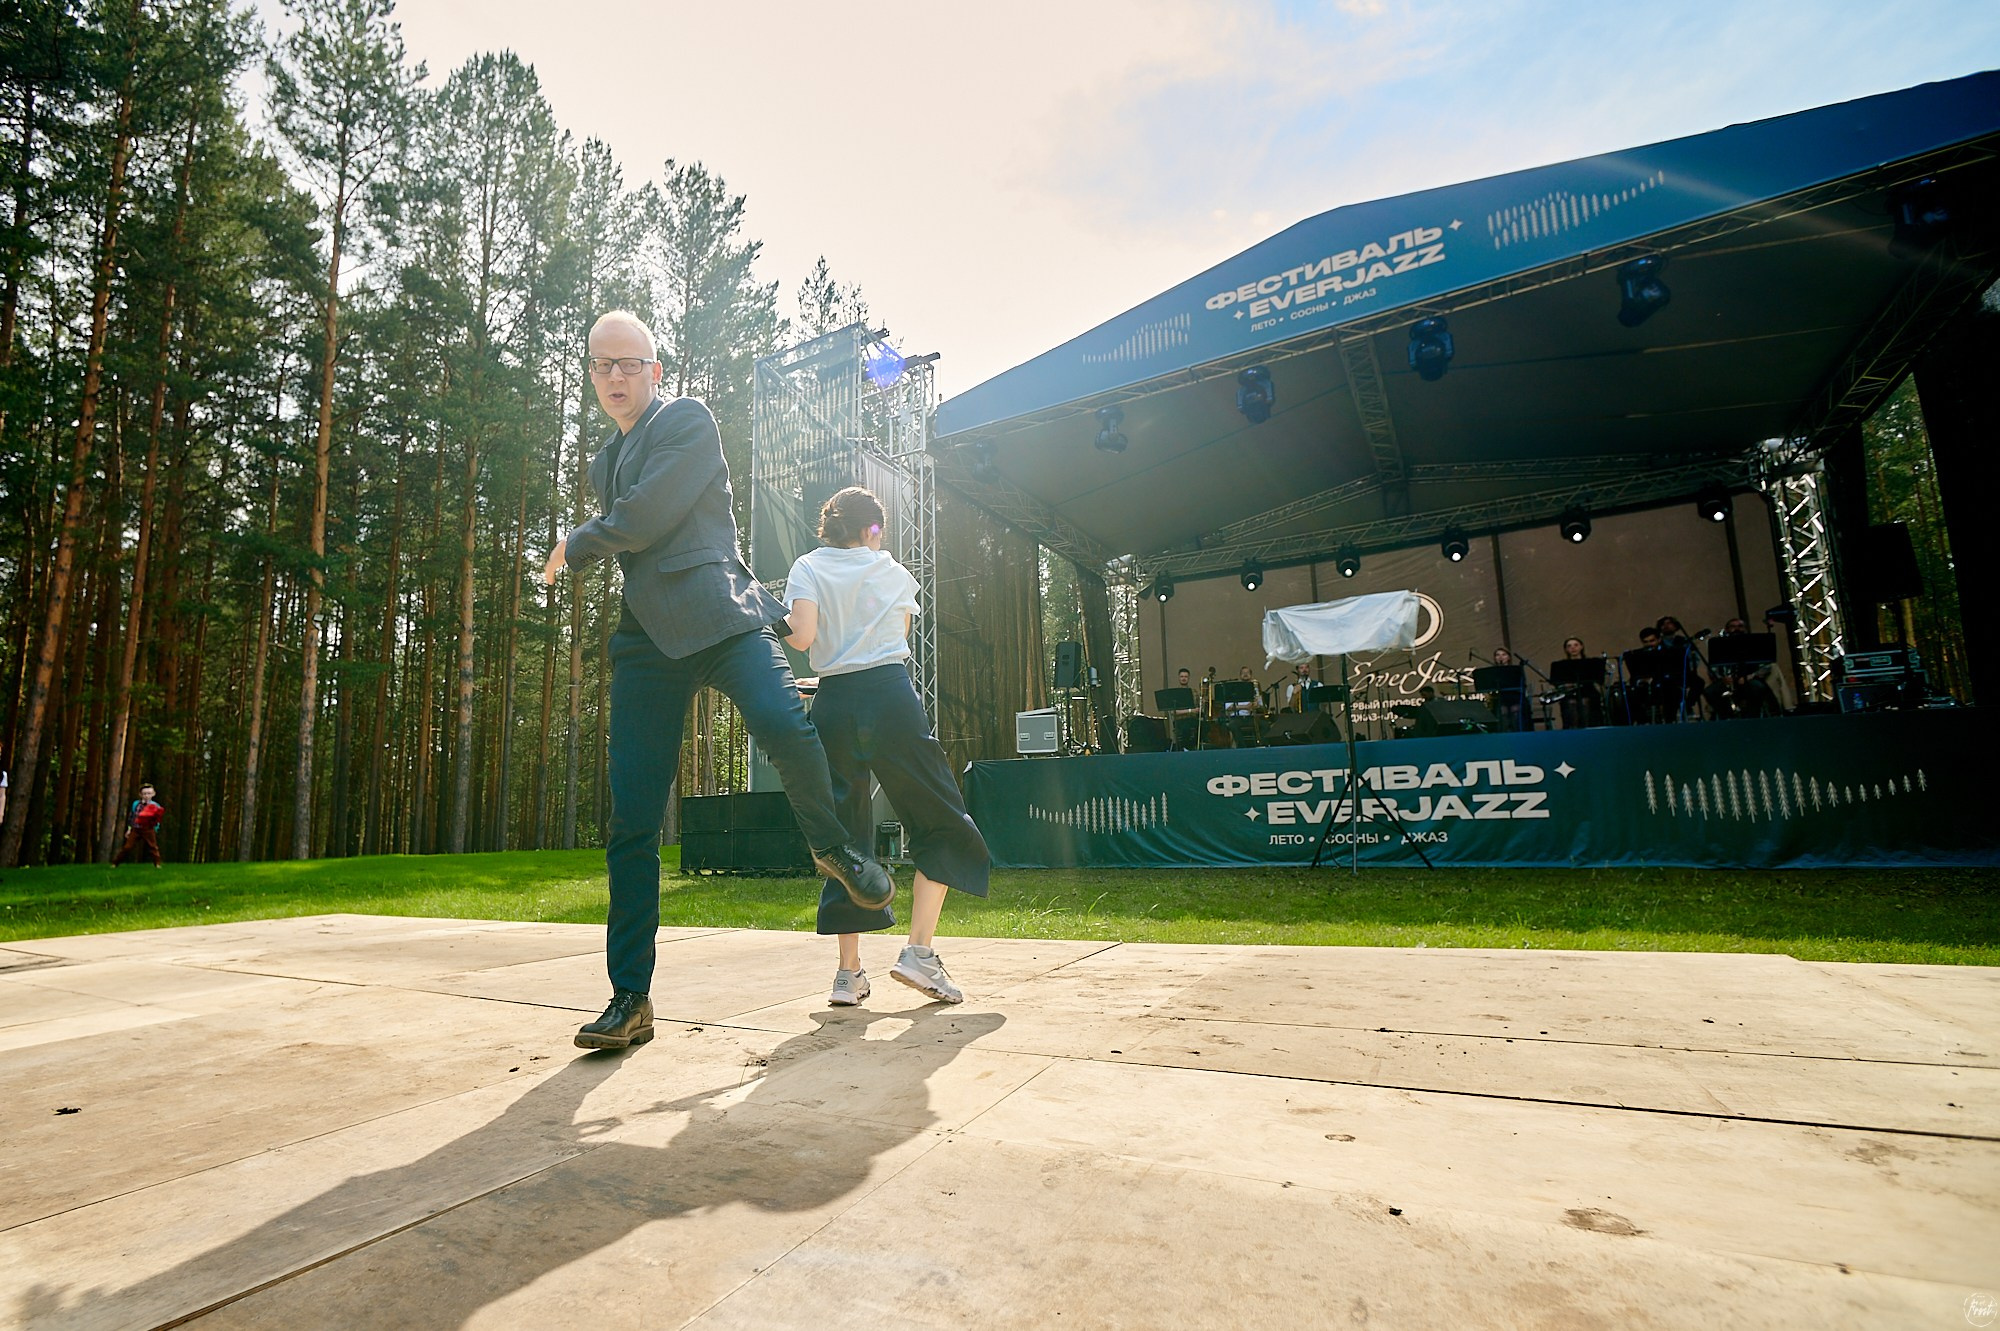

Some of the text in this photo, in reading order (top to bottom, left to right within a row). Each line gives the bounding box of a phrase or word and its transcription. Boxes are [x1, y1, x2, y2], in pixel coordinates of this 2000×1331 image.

[1205, 227, 1443, 310] ФЕСТИВАЛЬ
[1250, 242, 1446, 319] EVERJAZZ
[1250, 288, 1377, 332] ЛЕТО СОСНЫ ДЖАЗ
[1266, 792, 1550, 825] EVERJAZZ
[1269, 834, 1305, 845] ЛЕТО
